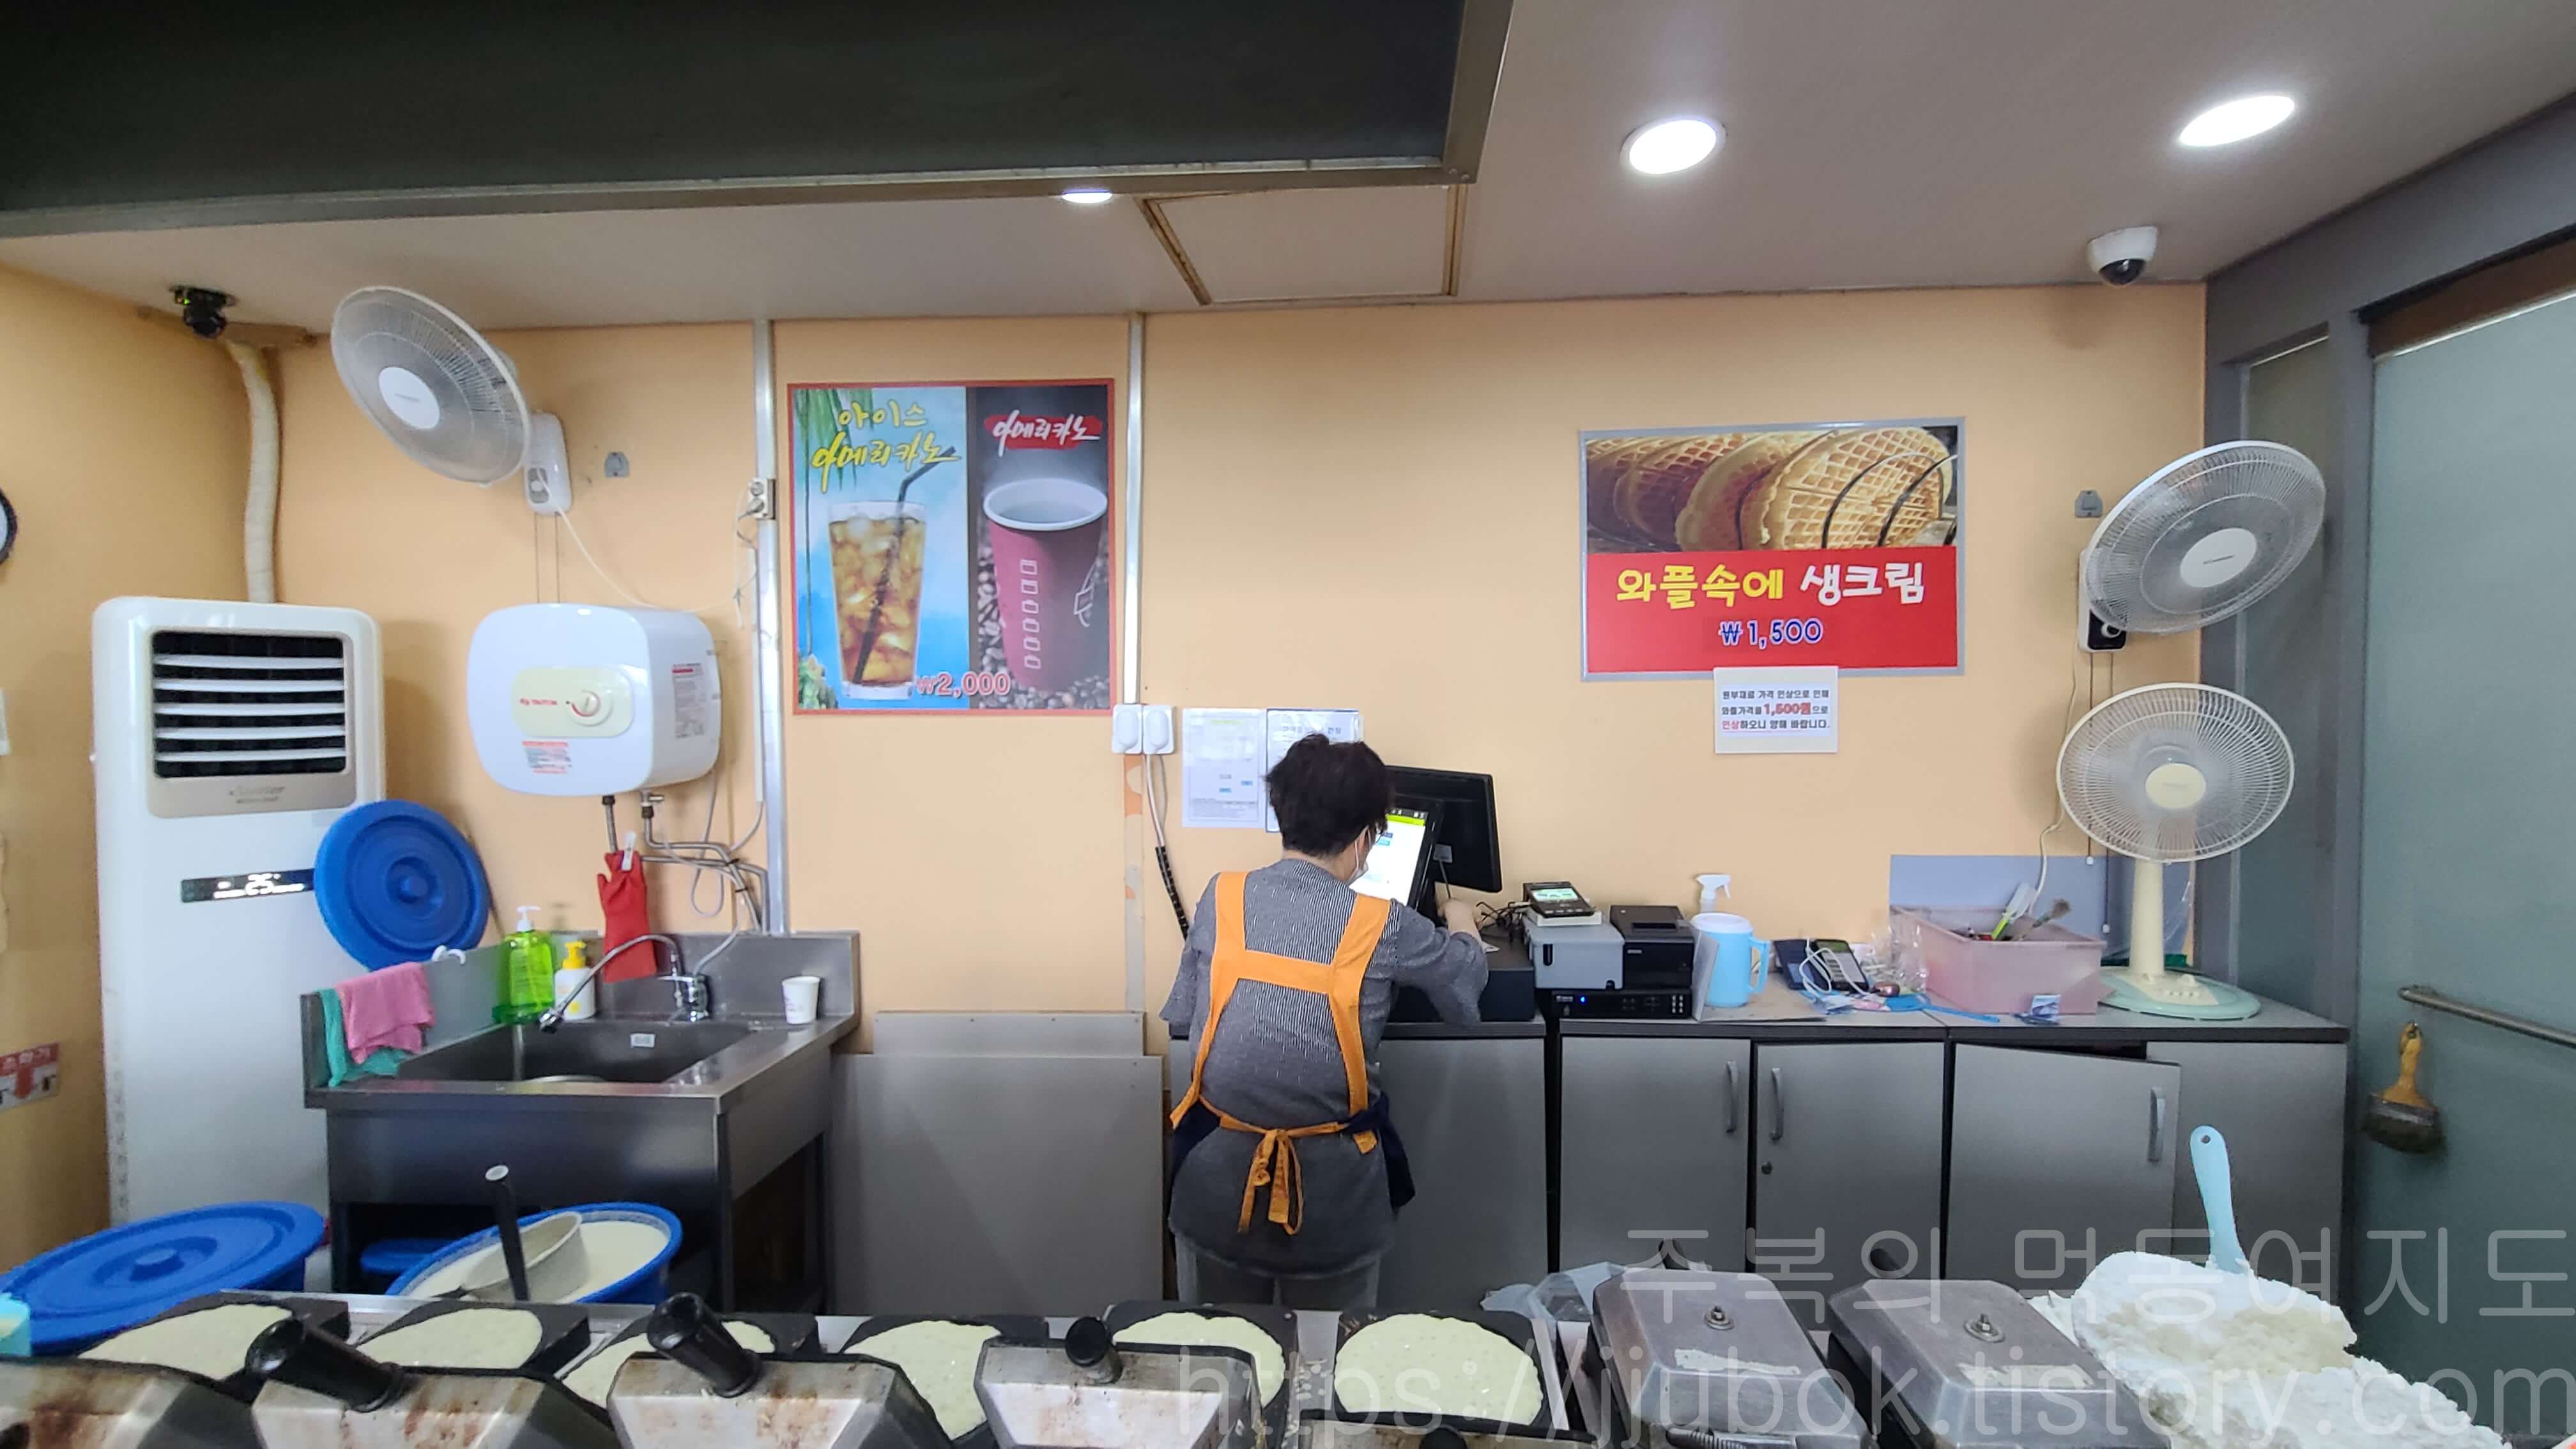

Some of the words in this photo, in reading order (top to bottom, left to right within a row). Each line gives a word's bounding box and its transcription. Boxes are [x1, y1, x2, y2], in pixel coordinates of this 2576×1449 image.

[837, 399, 928, 431] 아이스
[992, 409, 1101, 457] 아메리카노
[811, 431, 962, 494] 아메리카노
[1616, 563, 1784, 610] 와플속에
[1799, 561, 1926, 607] 생크림
[1758, 690, 1774, 699] 가격
[1777, 689, 1810, 699] 인상으로
[1769, 719, 1788, 729] 양해
